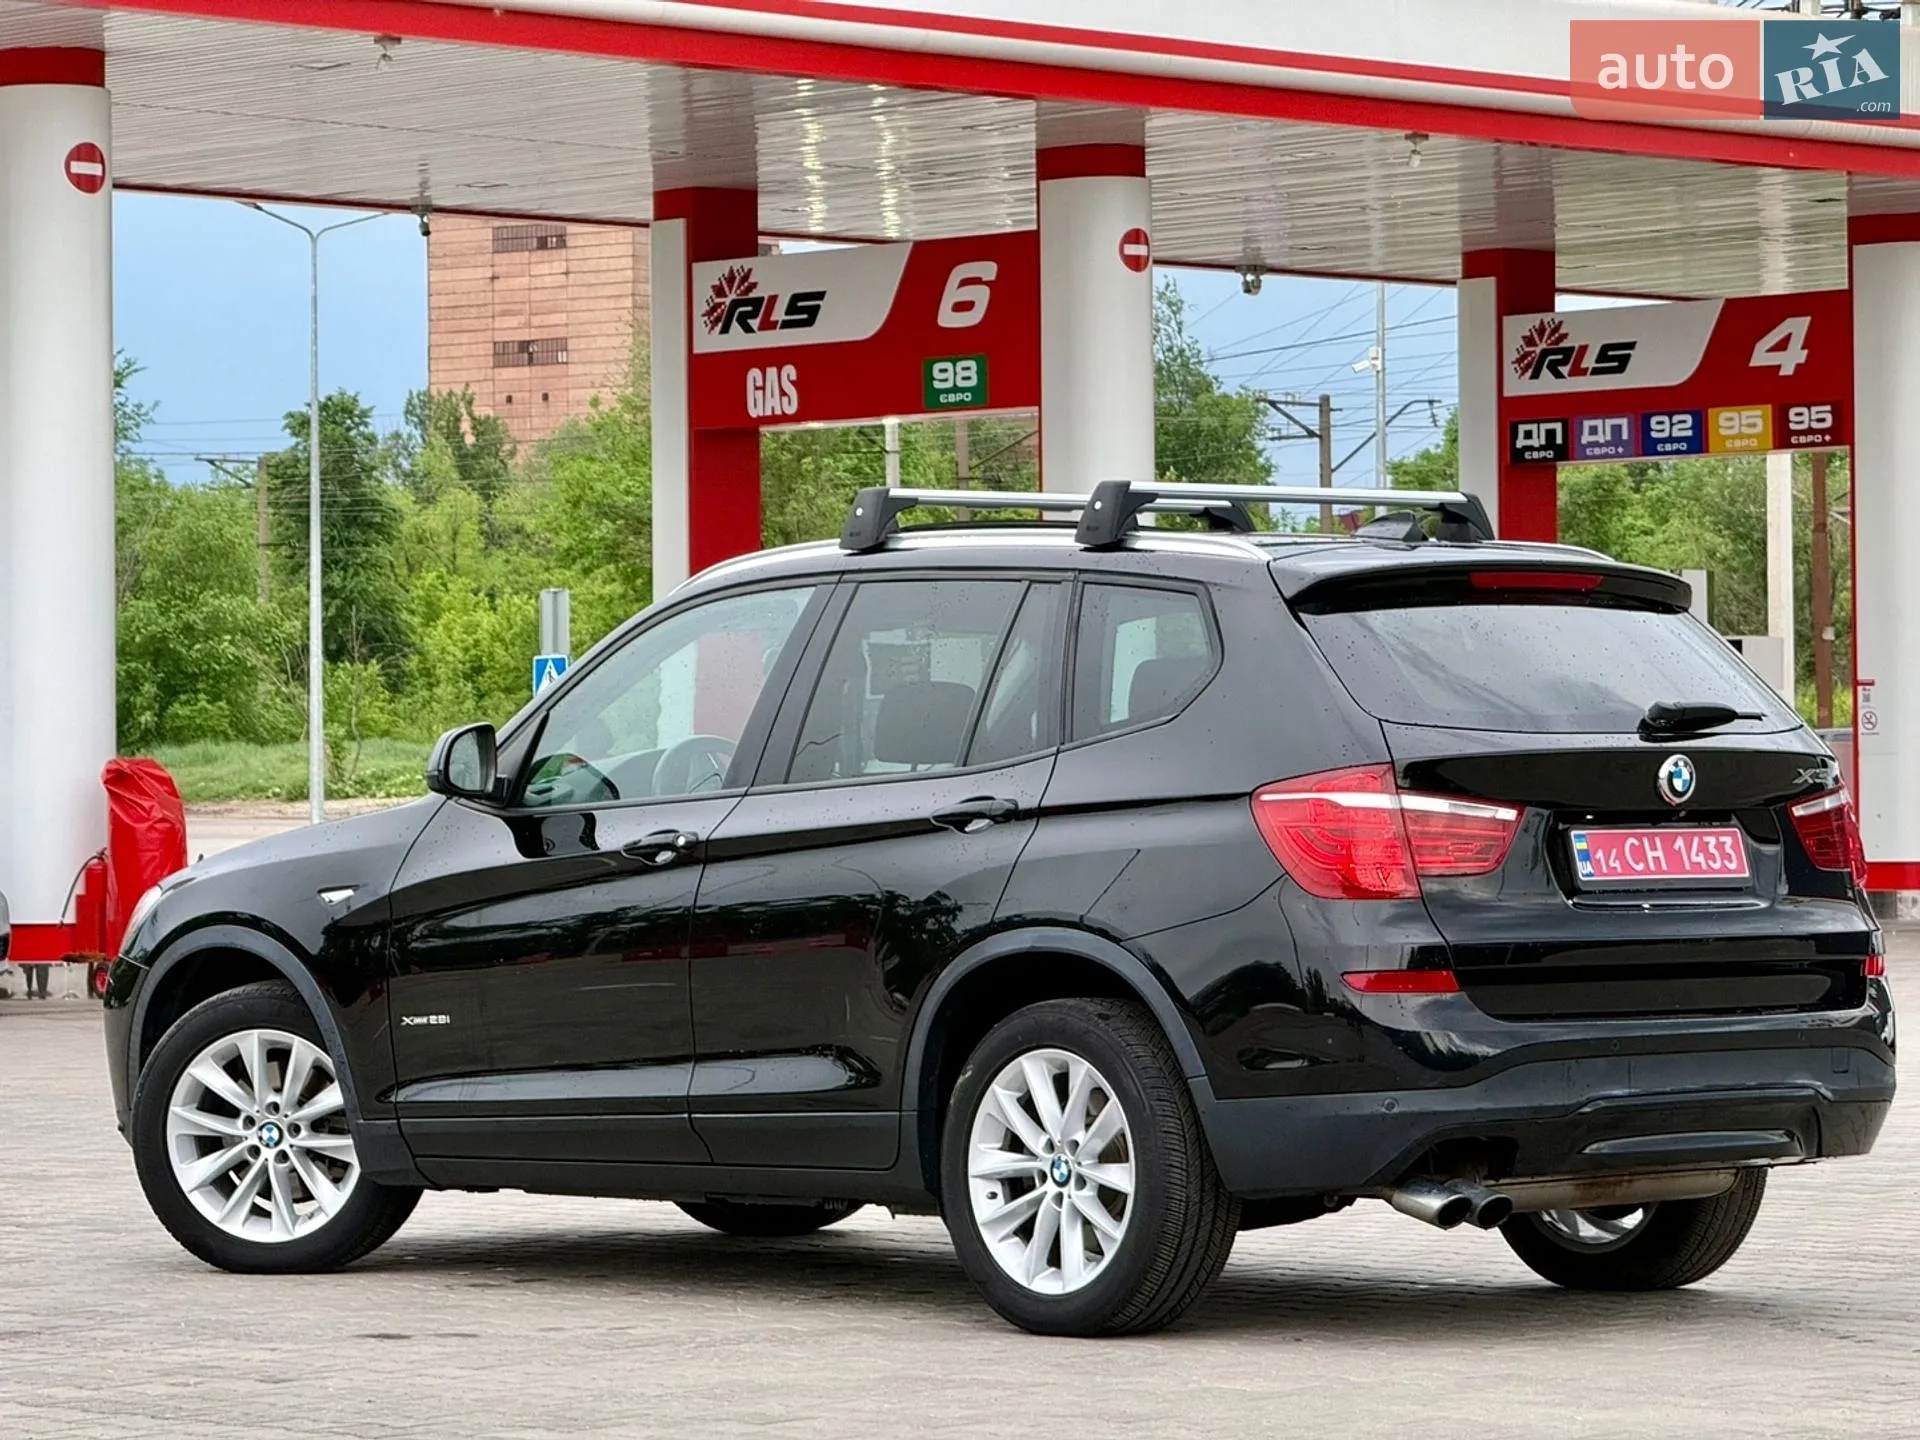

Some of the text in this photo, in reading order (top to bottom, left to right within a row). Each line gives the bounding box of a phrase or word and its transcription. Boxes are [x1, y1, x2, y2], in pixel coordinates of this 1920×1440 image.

[937, 260, 998, 328] 6
[718, 290, 827, 335] RLS
[1529, 341, 1637, 380] RLS
[1749, 316, 1811, 376] 4
[932, 360, 978, 389] 98
[746, 364, 799, 418] GAS
[1581, 417, 1629, 445] ДП
[1650, 414, 1693, 439] 92
[1718, 410, 1764, 436] 95
[1788, 405, 1833, 430] 95
[1515, 422, 1563, 448] ДП
[1579, 861, 1594, 875] UA
[1595, 835, 1738, 874] 14 CH 1433
